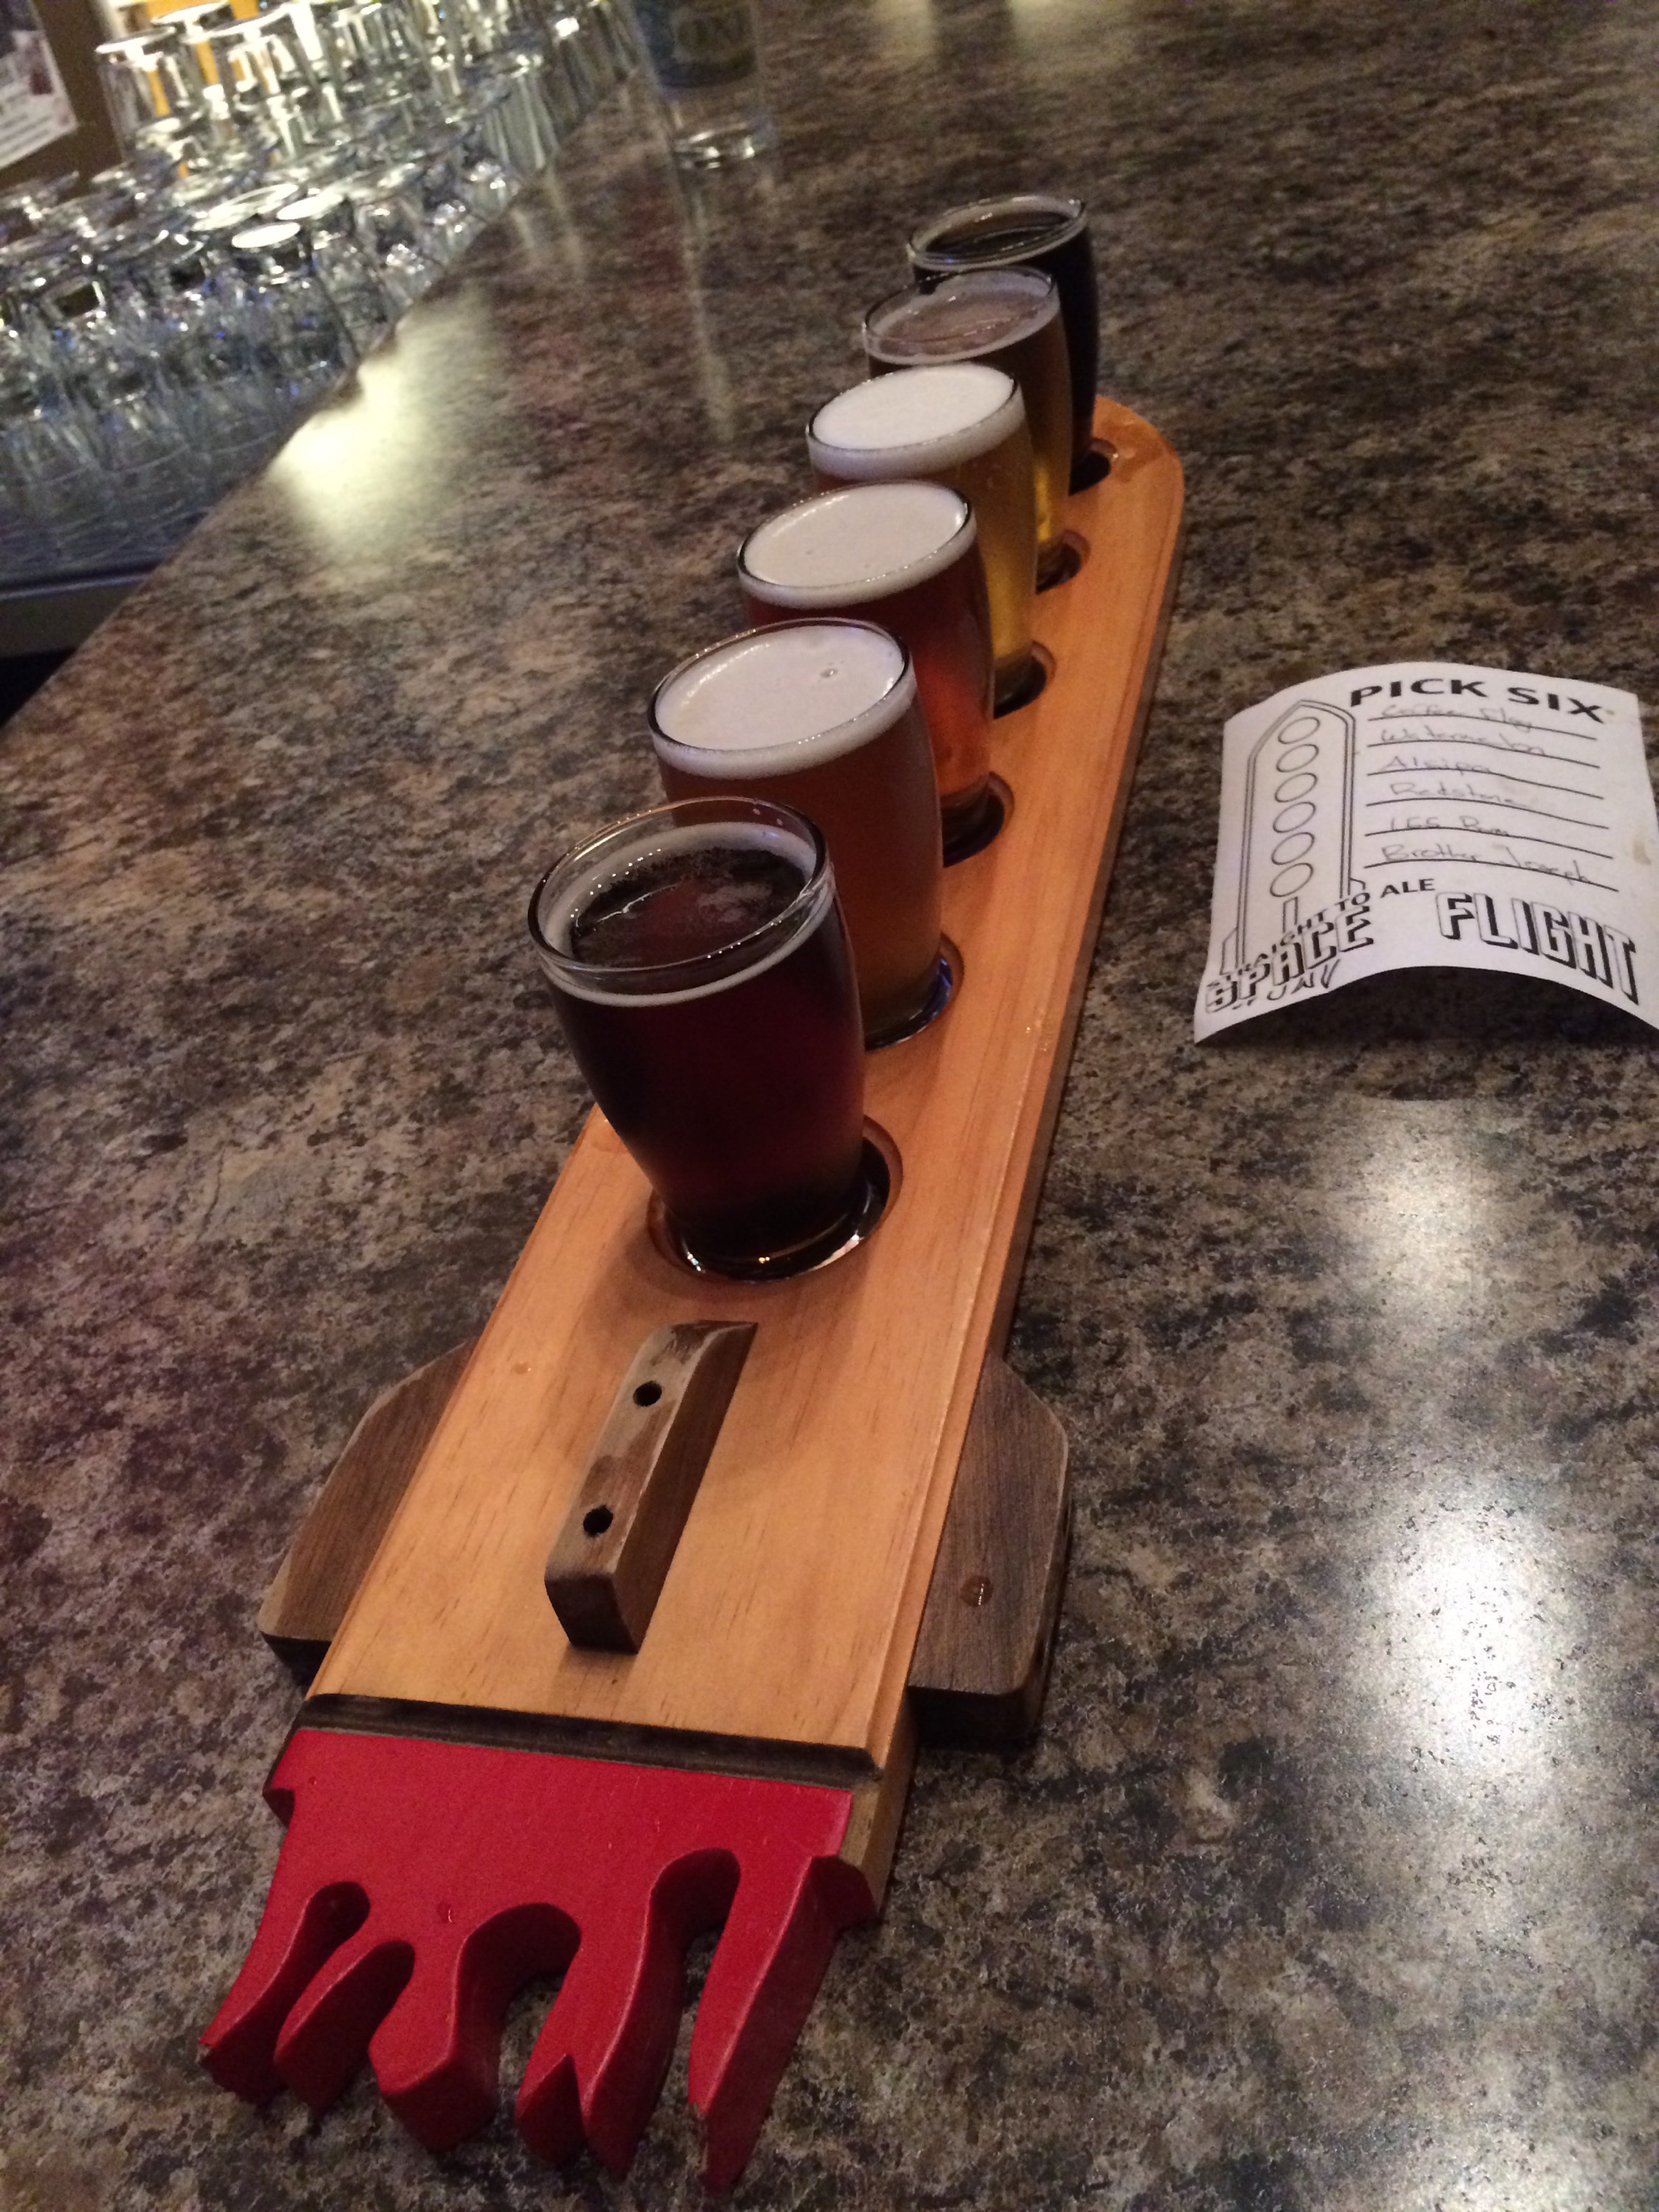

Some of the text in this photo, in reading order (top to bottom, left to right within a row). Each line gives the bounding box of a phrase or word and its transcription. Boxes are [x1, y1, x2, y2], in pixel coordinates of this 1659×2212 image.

[1350, 678, 1604, 724] PICK SIX
[1390, 781, 1522, 806] Redstone
[1381, 844, 1591, 886] Brother Joseph
[1335, 891, 1371, 912] TO
[1380, 878, 1436, 899] ALE
[1204, 892, 1640, 1015] SPACE FLIGHT
